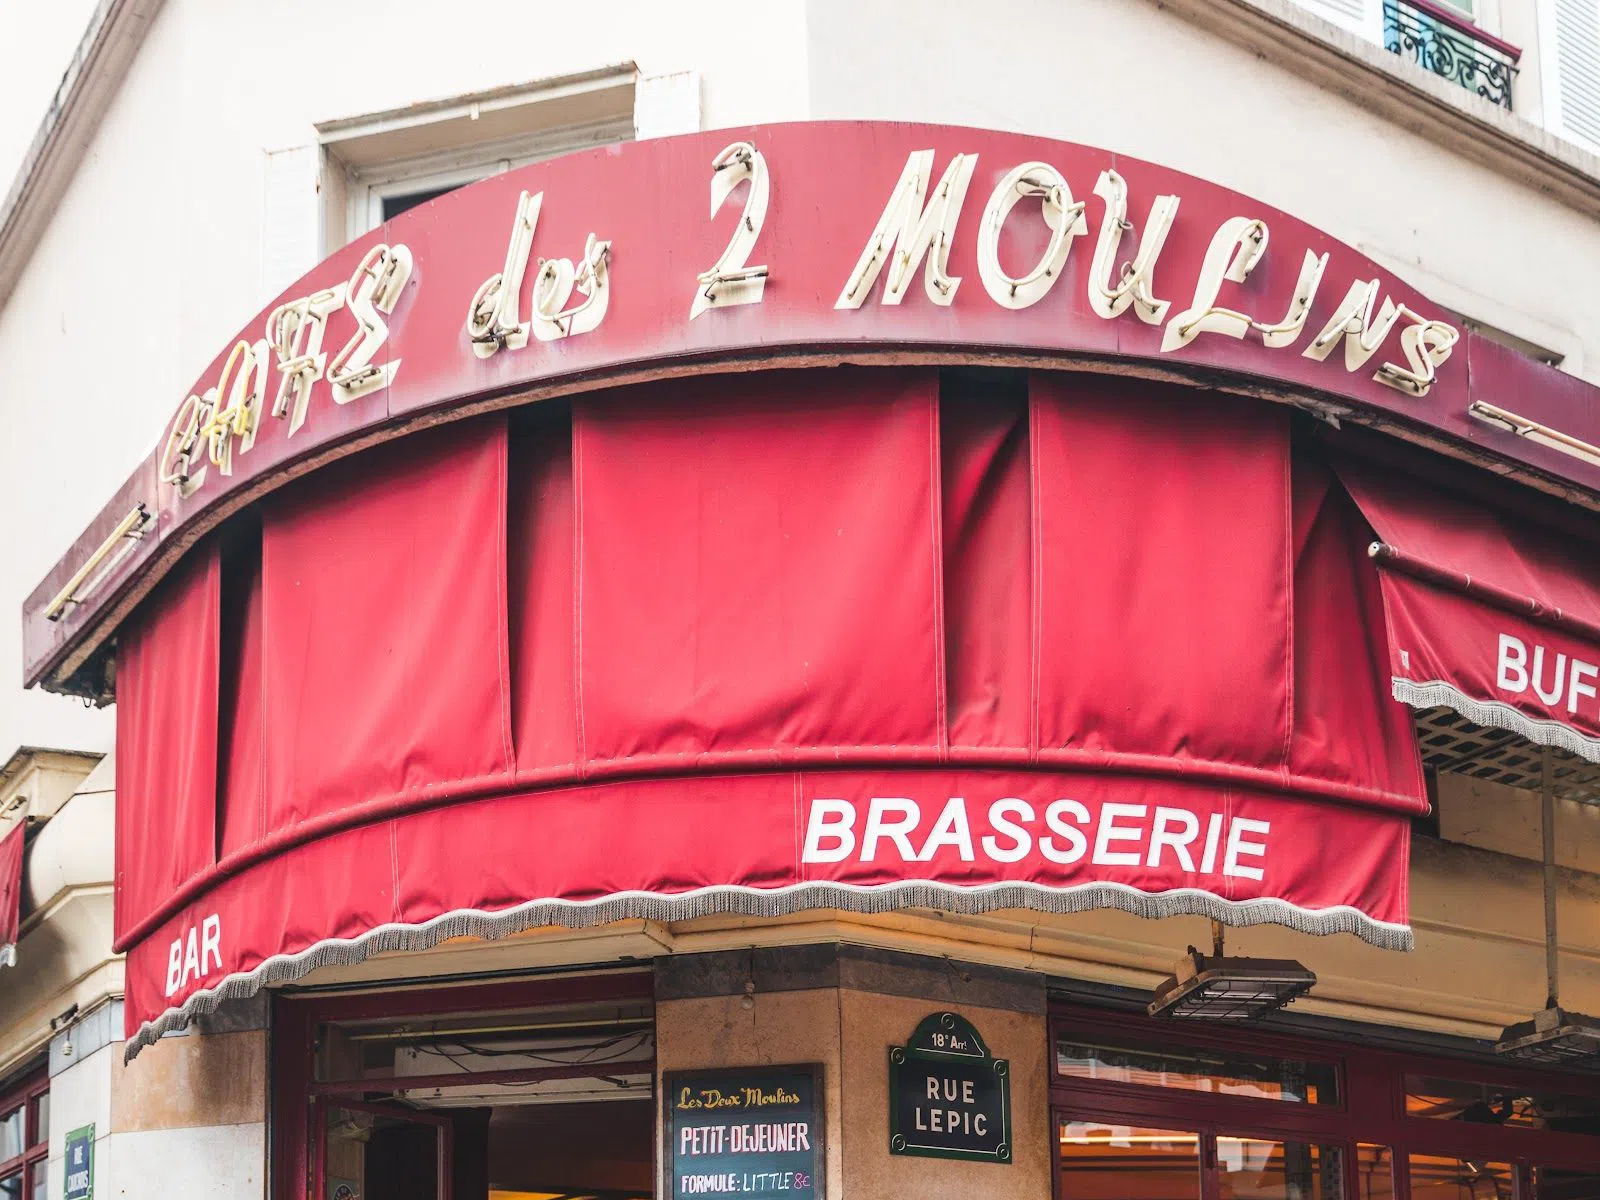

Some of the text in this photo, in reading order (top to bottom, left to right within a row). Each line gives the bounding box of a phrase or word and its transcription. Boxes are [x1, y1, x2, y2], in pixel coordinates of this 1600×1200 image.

[689, 142, 769, 320] 2
[1497, 633, 1600, 721] BUF
[801, 798, 1270, 882] BRASSERIE
[166, 912, 223, 998] BAR
[677, 1087, 801, 1109] Les Deux Moulins
[926, 1076, 975, 1104] RUE
[915, 1107, 987, 1137] LEPIC
[743, 1172, 794, 1192] LITTLE
